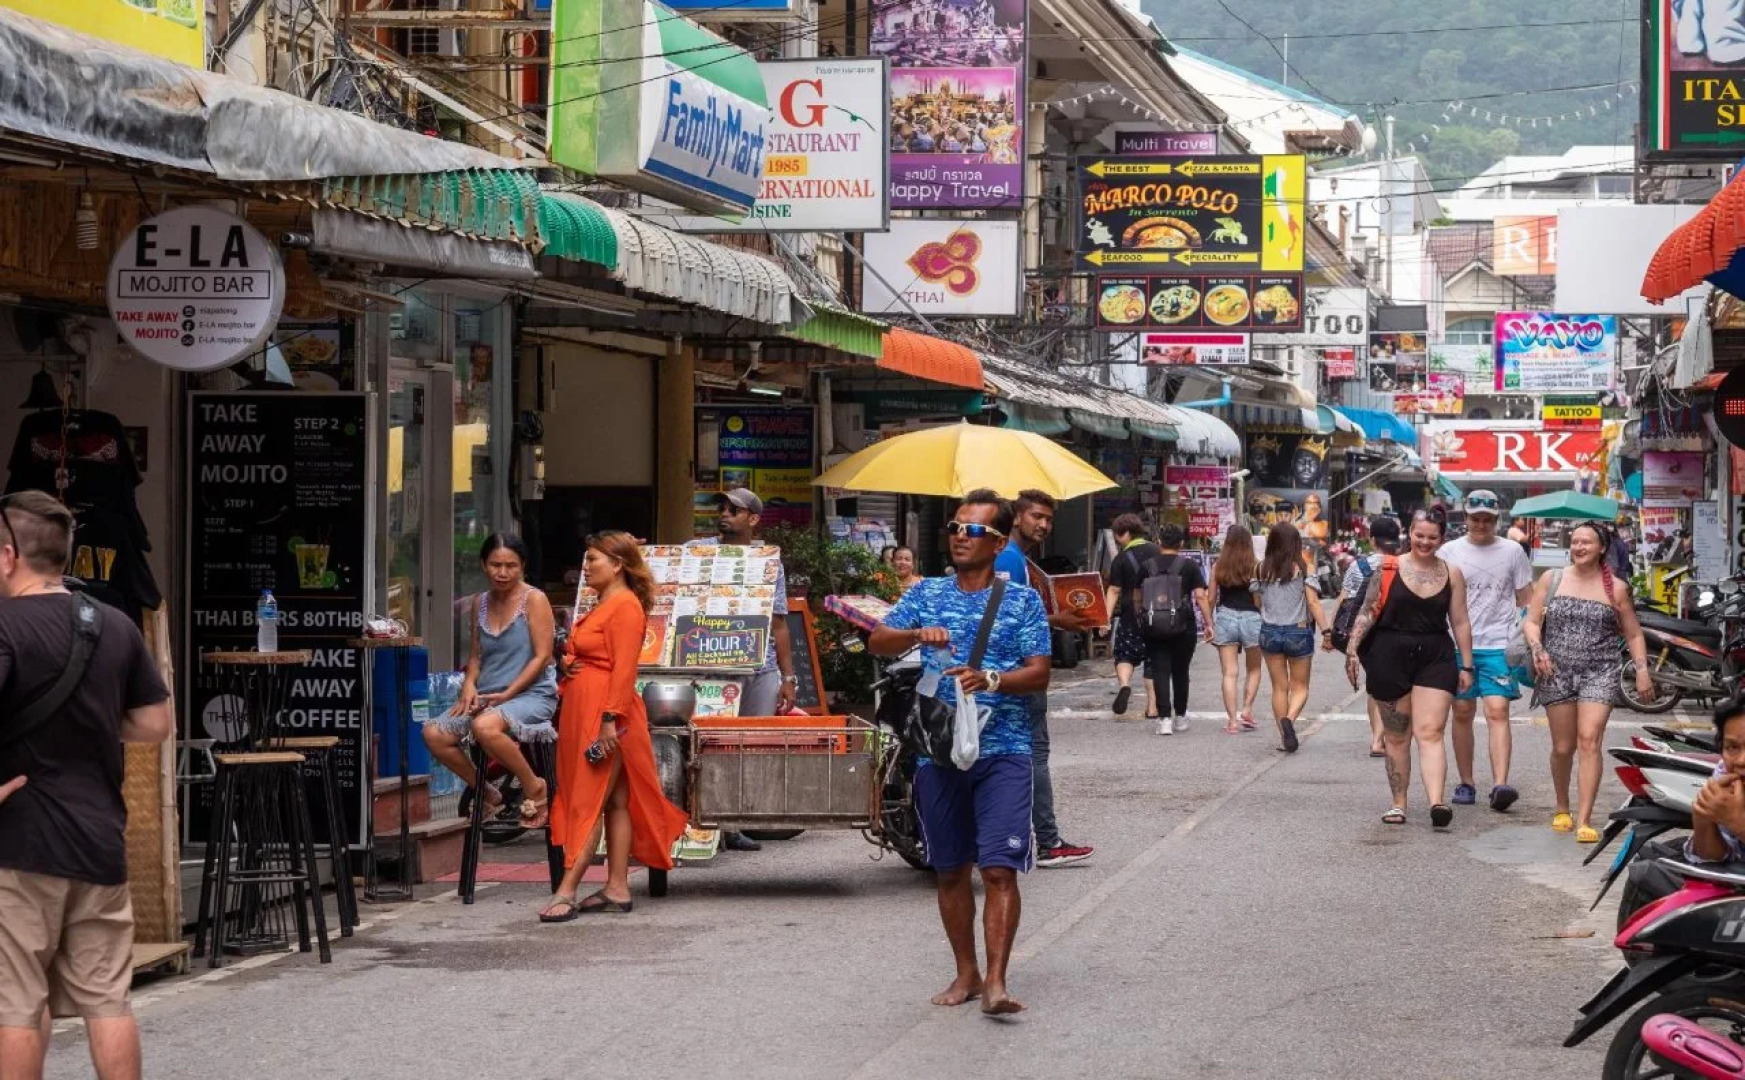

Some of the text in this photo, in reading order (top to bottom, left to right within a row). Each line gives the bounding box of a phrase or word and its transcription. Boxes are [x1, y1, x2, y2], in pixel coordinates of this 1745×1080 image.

[1683, 79, 1745, 101] ITA
[780, 78, 829, 128] G
[662, 78, 765, 179] FamilyMart
[769, 132, 861, 152] STAURANT
[1122, 137, 1213, 150] Multi Travel
[769, 159, 801, 173] 1985
[1103, 164, 1125, 173] THE
[1126, 164, 1150, 173] BEST
[1184, 164, 1211, 173] PIZZA
[1222, 164, 1250, 173] PASTA
[756, 179, 875, 199] ERNATIONAL
[950, 180, 1009, 198] Travel
[1085, 183, 1239, 215] MARCO POLO
[746, 204, 791, 218] ISINE
[1144, 209, 1199, 217] Sorrento
[135, 224, 249, 268] E-LA
[130, 276, 254, 293] MOJITO BAR
[905, 291, 945, 303] THAI
[116, 311, 180, 322] TAKE AWAY
[1306, 314, 1364, 335] TOO
[135, 328, 181, 339] MOJITO
[1507, 320, 1605, 350] VAYO
[201, 403, 258, 424] TAKE
[1554, 407, 1593, 417] TATTOO
[294, 418, 340, 431] STEP 2
[201, 434, 267, 453] AWAY
[720, 437, 809, 449] NFORMATION
[1492, 432, 1579, 471] RK
[201, 464, 288, 484] MOJITO
[224, 499, 247, 509] STEP
[194, 610, 363, 628] THAI BRS 80THB
[694, 615, 732, 630] Happy
[700, 635, 741, 652] HOUR
[290, 678, 358, 698] AWAY
[275, 708, 361, 728] COFFEE
